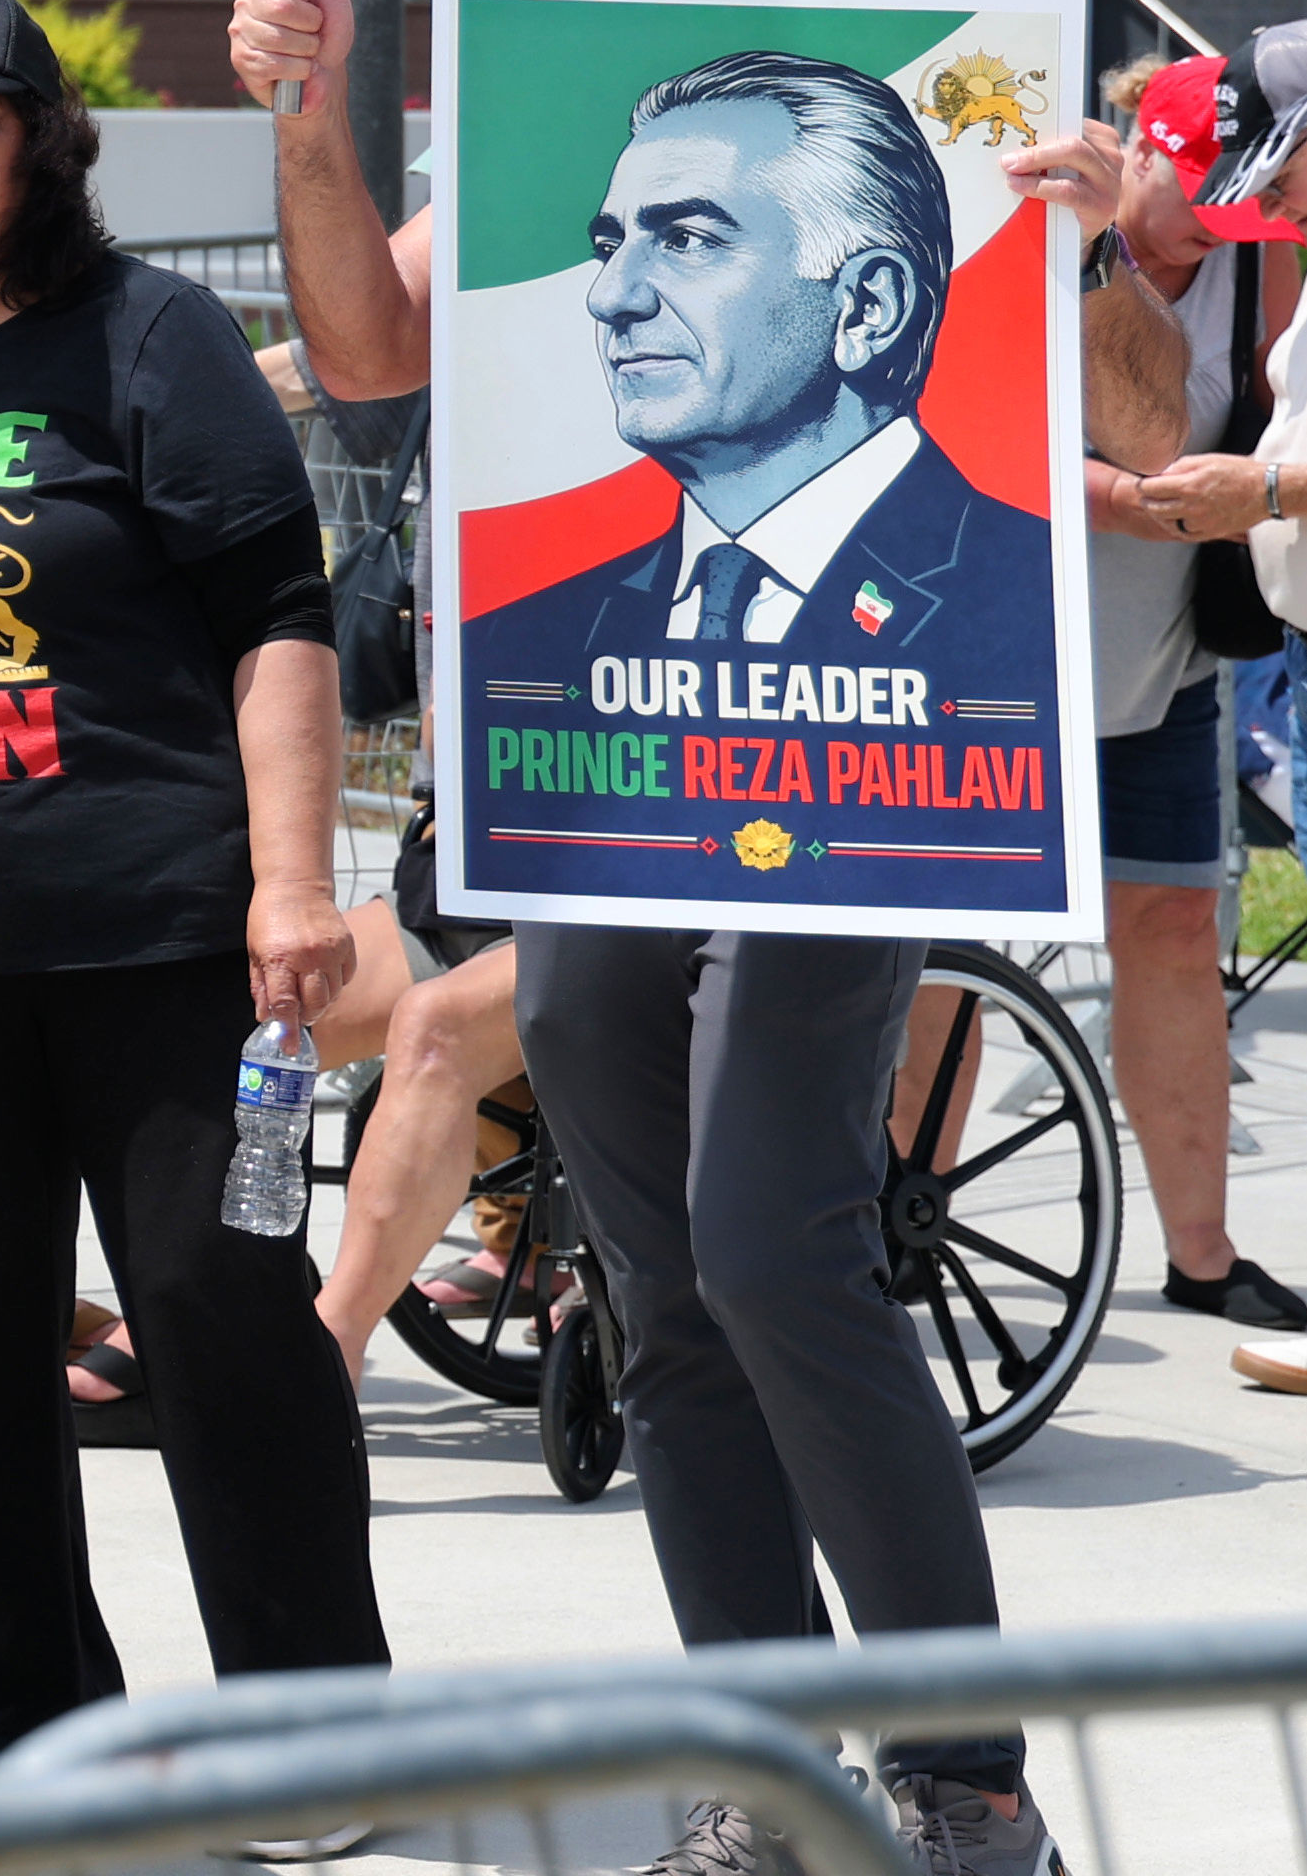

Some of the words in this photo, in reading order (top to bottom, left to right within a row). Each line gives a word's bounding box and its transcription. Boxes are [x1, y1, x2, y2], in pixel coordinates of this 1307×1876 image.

[1149, 120, 1186, 153] 45-47
[590, 656, 702, 717] OUR
[716, 661, 929, 726] LEADER
[488, 727, 671, 798] PRINCE
[683, 735, 814, 803] REZA
[827, 740, 1043, 811] PAHLAVI
